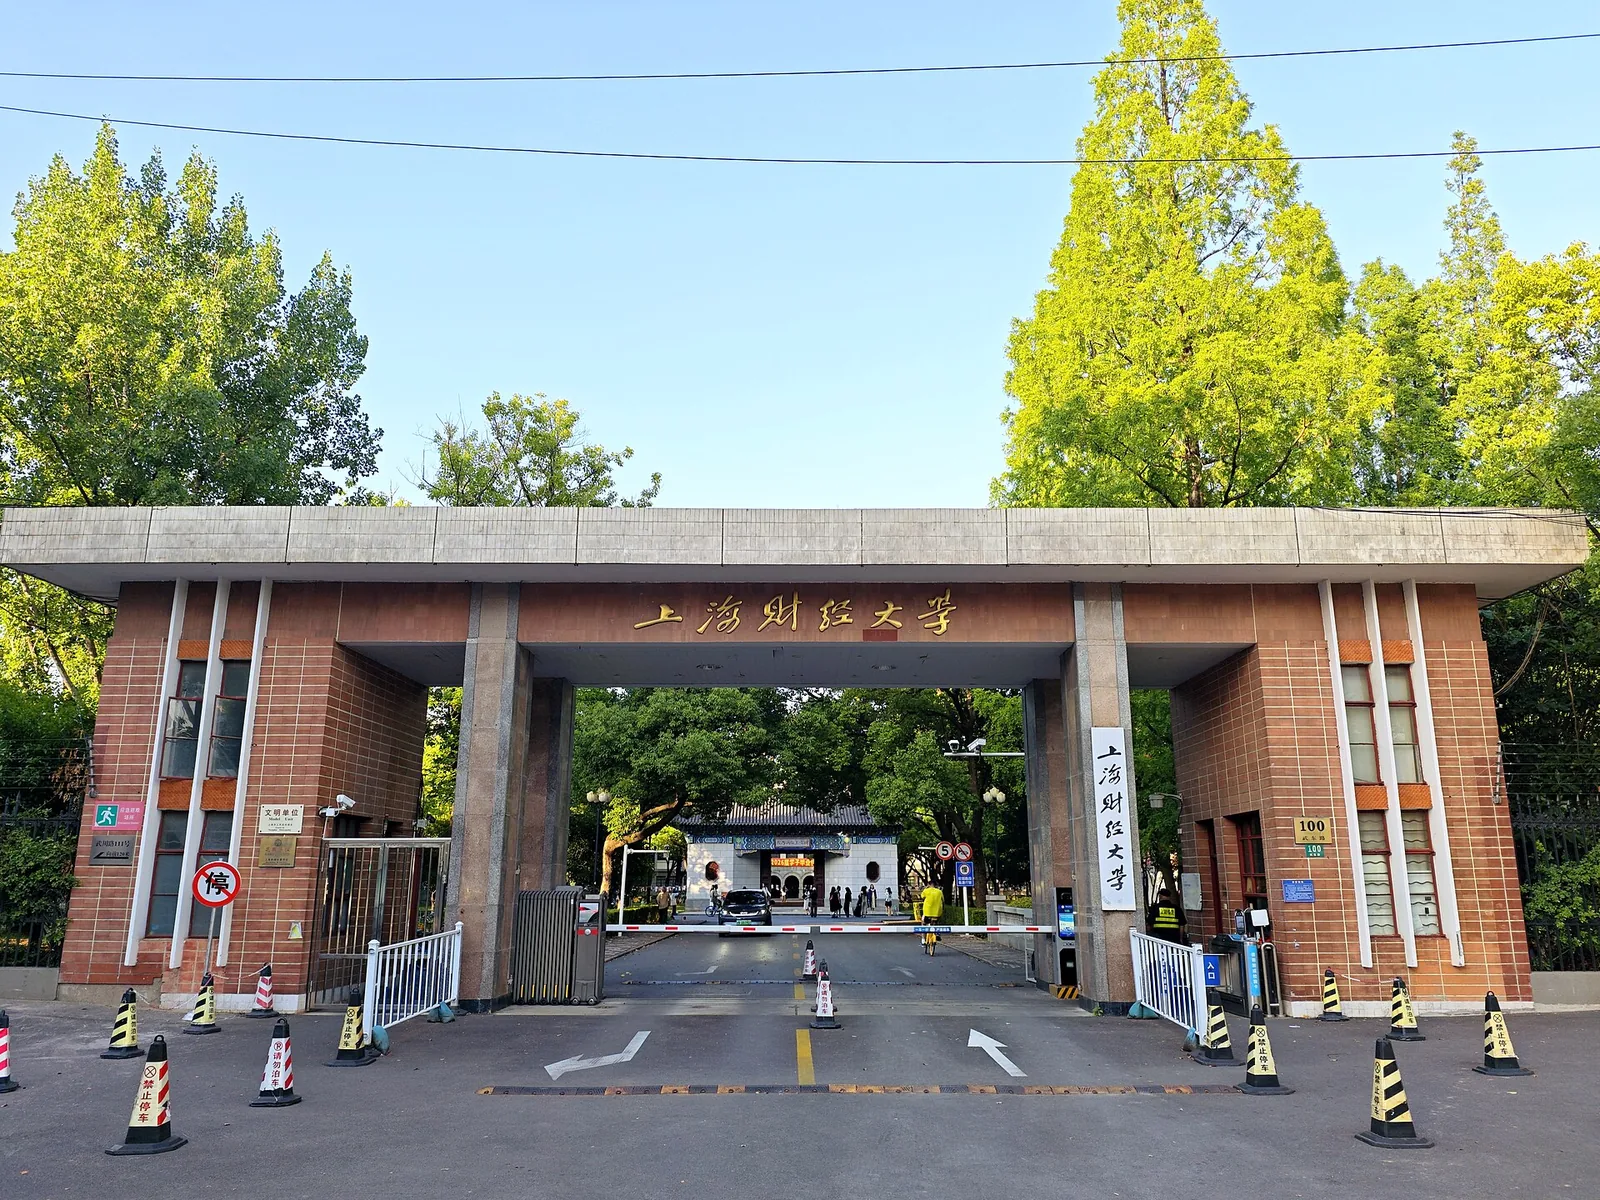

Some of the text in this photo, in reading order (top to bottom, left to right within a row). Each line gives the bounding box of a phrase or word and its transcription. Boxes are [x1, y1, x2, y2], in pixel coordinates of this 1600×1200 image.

[633, 587, 957, 636] 上海财经大学
[264, 808, 299, 817] 文明单位
[1096, 745, 1127, 891] 上海财经大学
[1299, 820, 1325, 832] 100
[941, 845, 949, 857] 5
[1307, 845, 1322, 853] 100
[205, 871, 230, 896] 停
[1207, 961, 1216, 980] 入口
[343, 1017, 354, 1048] 禁止停车
[1495, 1023, 1508, 1056] 禁止停车
[271, 1051, 282, 1087] 请勿泊车
[1257, 1038, 1270, 1072] 禁止停车
[137, 1079, 155, 1123] 禁止停车
